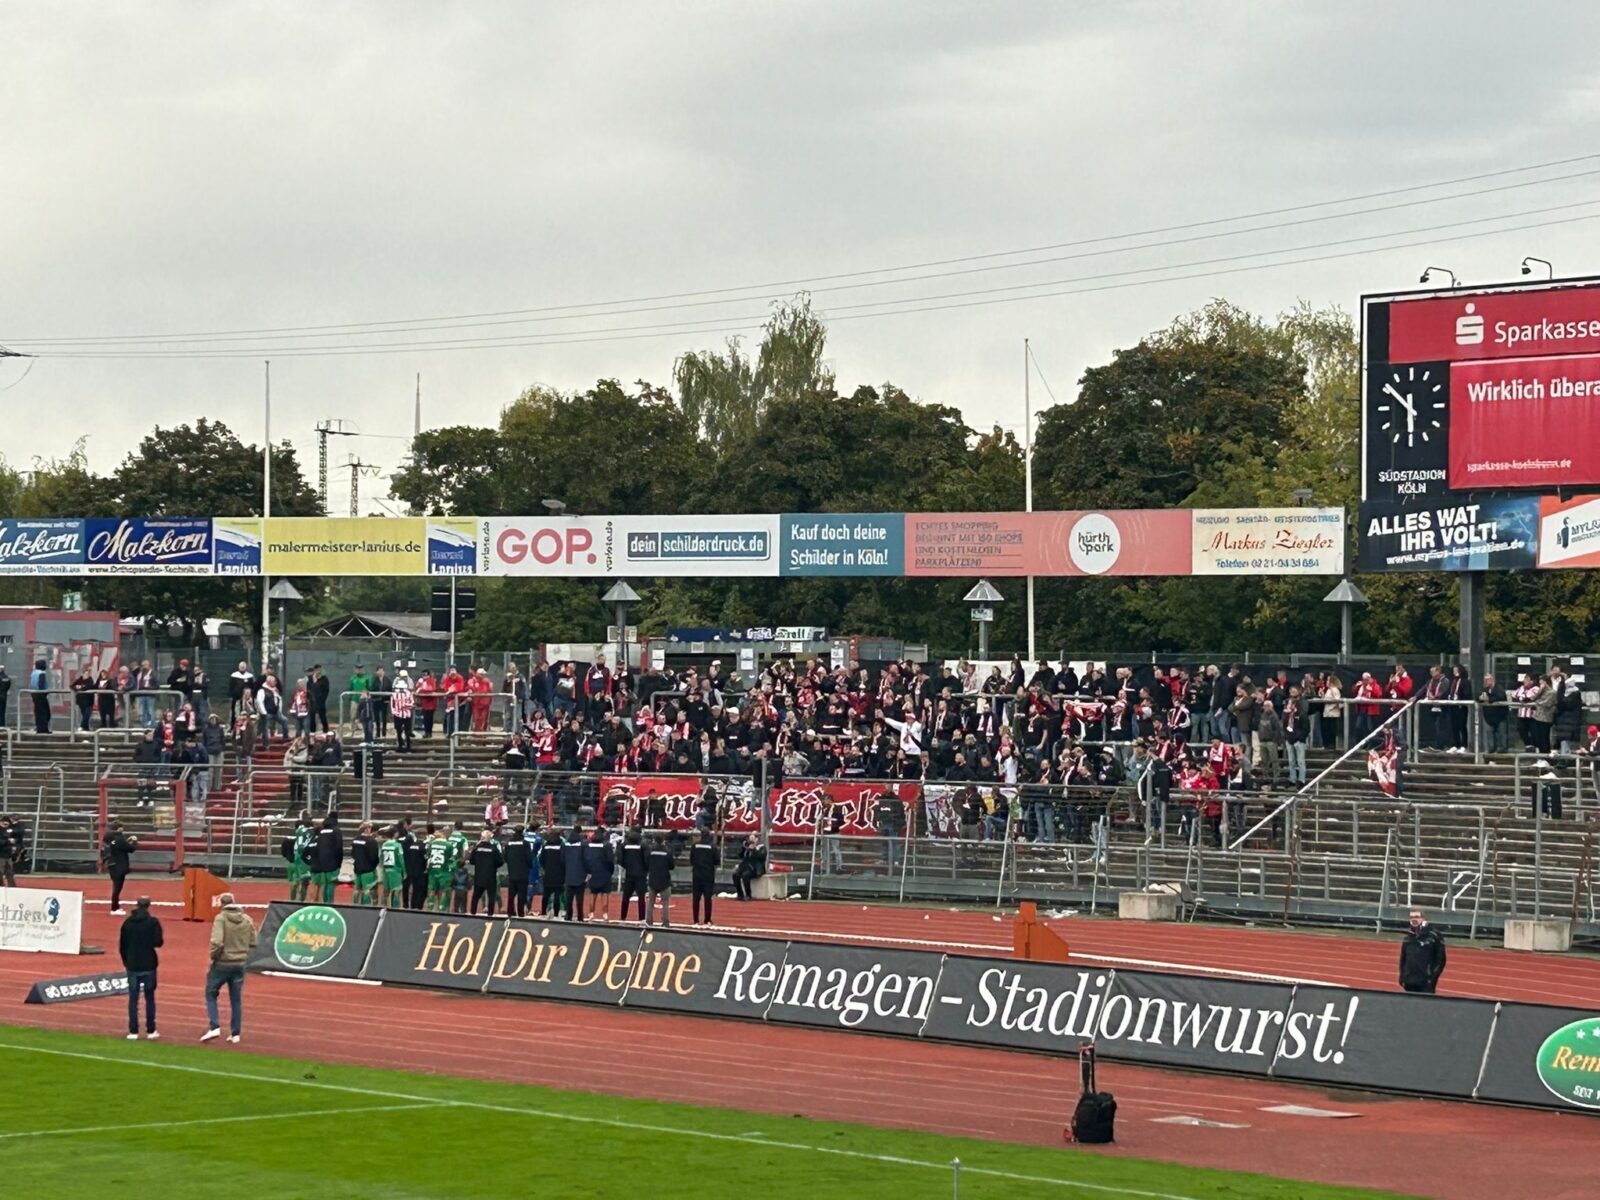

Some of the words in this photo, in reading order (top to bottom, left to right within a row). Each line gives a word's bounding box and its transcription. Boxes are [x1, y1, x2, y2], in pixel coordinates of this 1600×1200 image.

[1494, 318, 1600, 348] Sparkasse
[1468, 378, 1545, 402] Wirklich
[1379, 469, 1446, 483] SÜDSTADION
[1398, 482, 1426, 494] KÖLN
[1367, 512, 1431, 536] ALLES
[1436, 505, 1480, 527] WAT
[0, 527, 80, 558] alzkorn
[88, 520, 208, 562] Malzkorn
[791, 524, 819, 541] Kauf
[821, 524, 851, 541] doch
[853, 523, 887, 540] deine
[1078, 532, 1110, 543] hürth
[1211, 530, 1267, 550] Markus
[1272, 529, 1335, 554] Ziegler
[1401, 528, 1436, 551] IHR
[1441, 522, 1498, 545] VOLT!
[268, 540, 422, 553] malermeister-lanius.de
[496, 528, 597, 565] GOP.
[630, 534, 656, 553] dein
[663, 534, 764, 553] schilderdruck.de
[1085, 542, 1114, 556] park
[790, 549, 841, 566] Schilder
[842, 549, 854, 565] in
[857, 548, 889, 565] Köln!
[217, 562, 259, 574] Lanius
[415, 922, 485, 975] Hol
[492, 927, 569, 983] Dir
[568, 934, 702, 995] Deine
